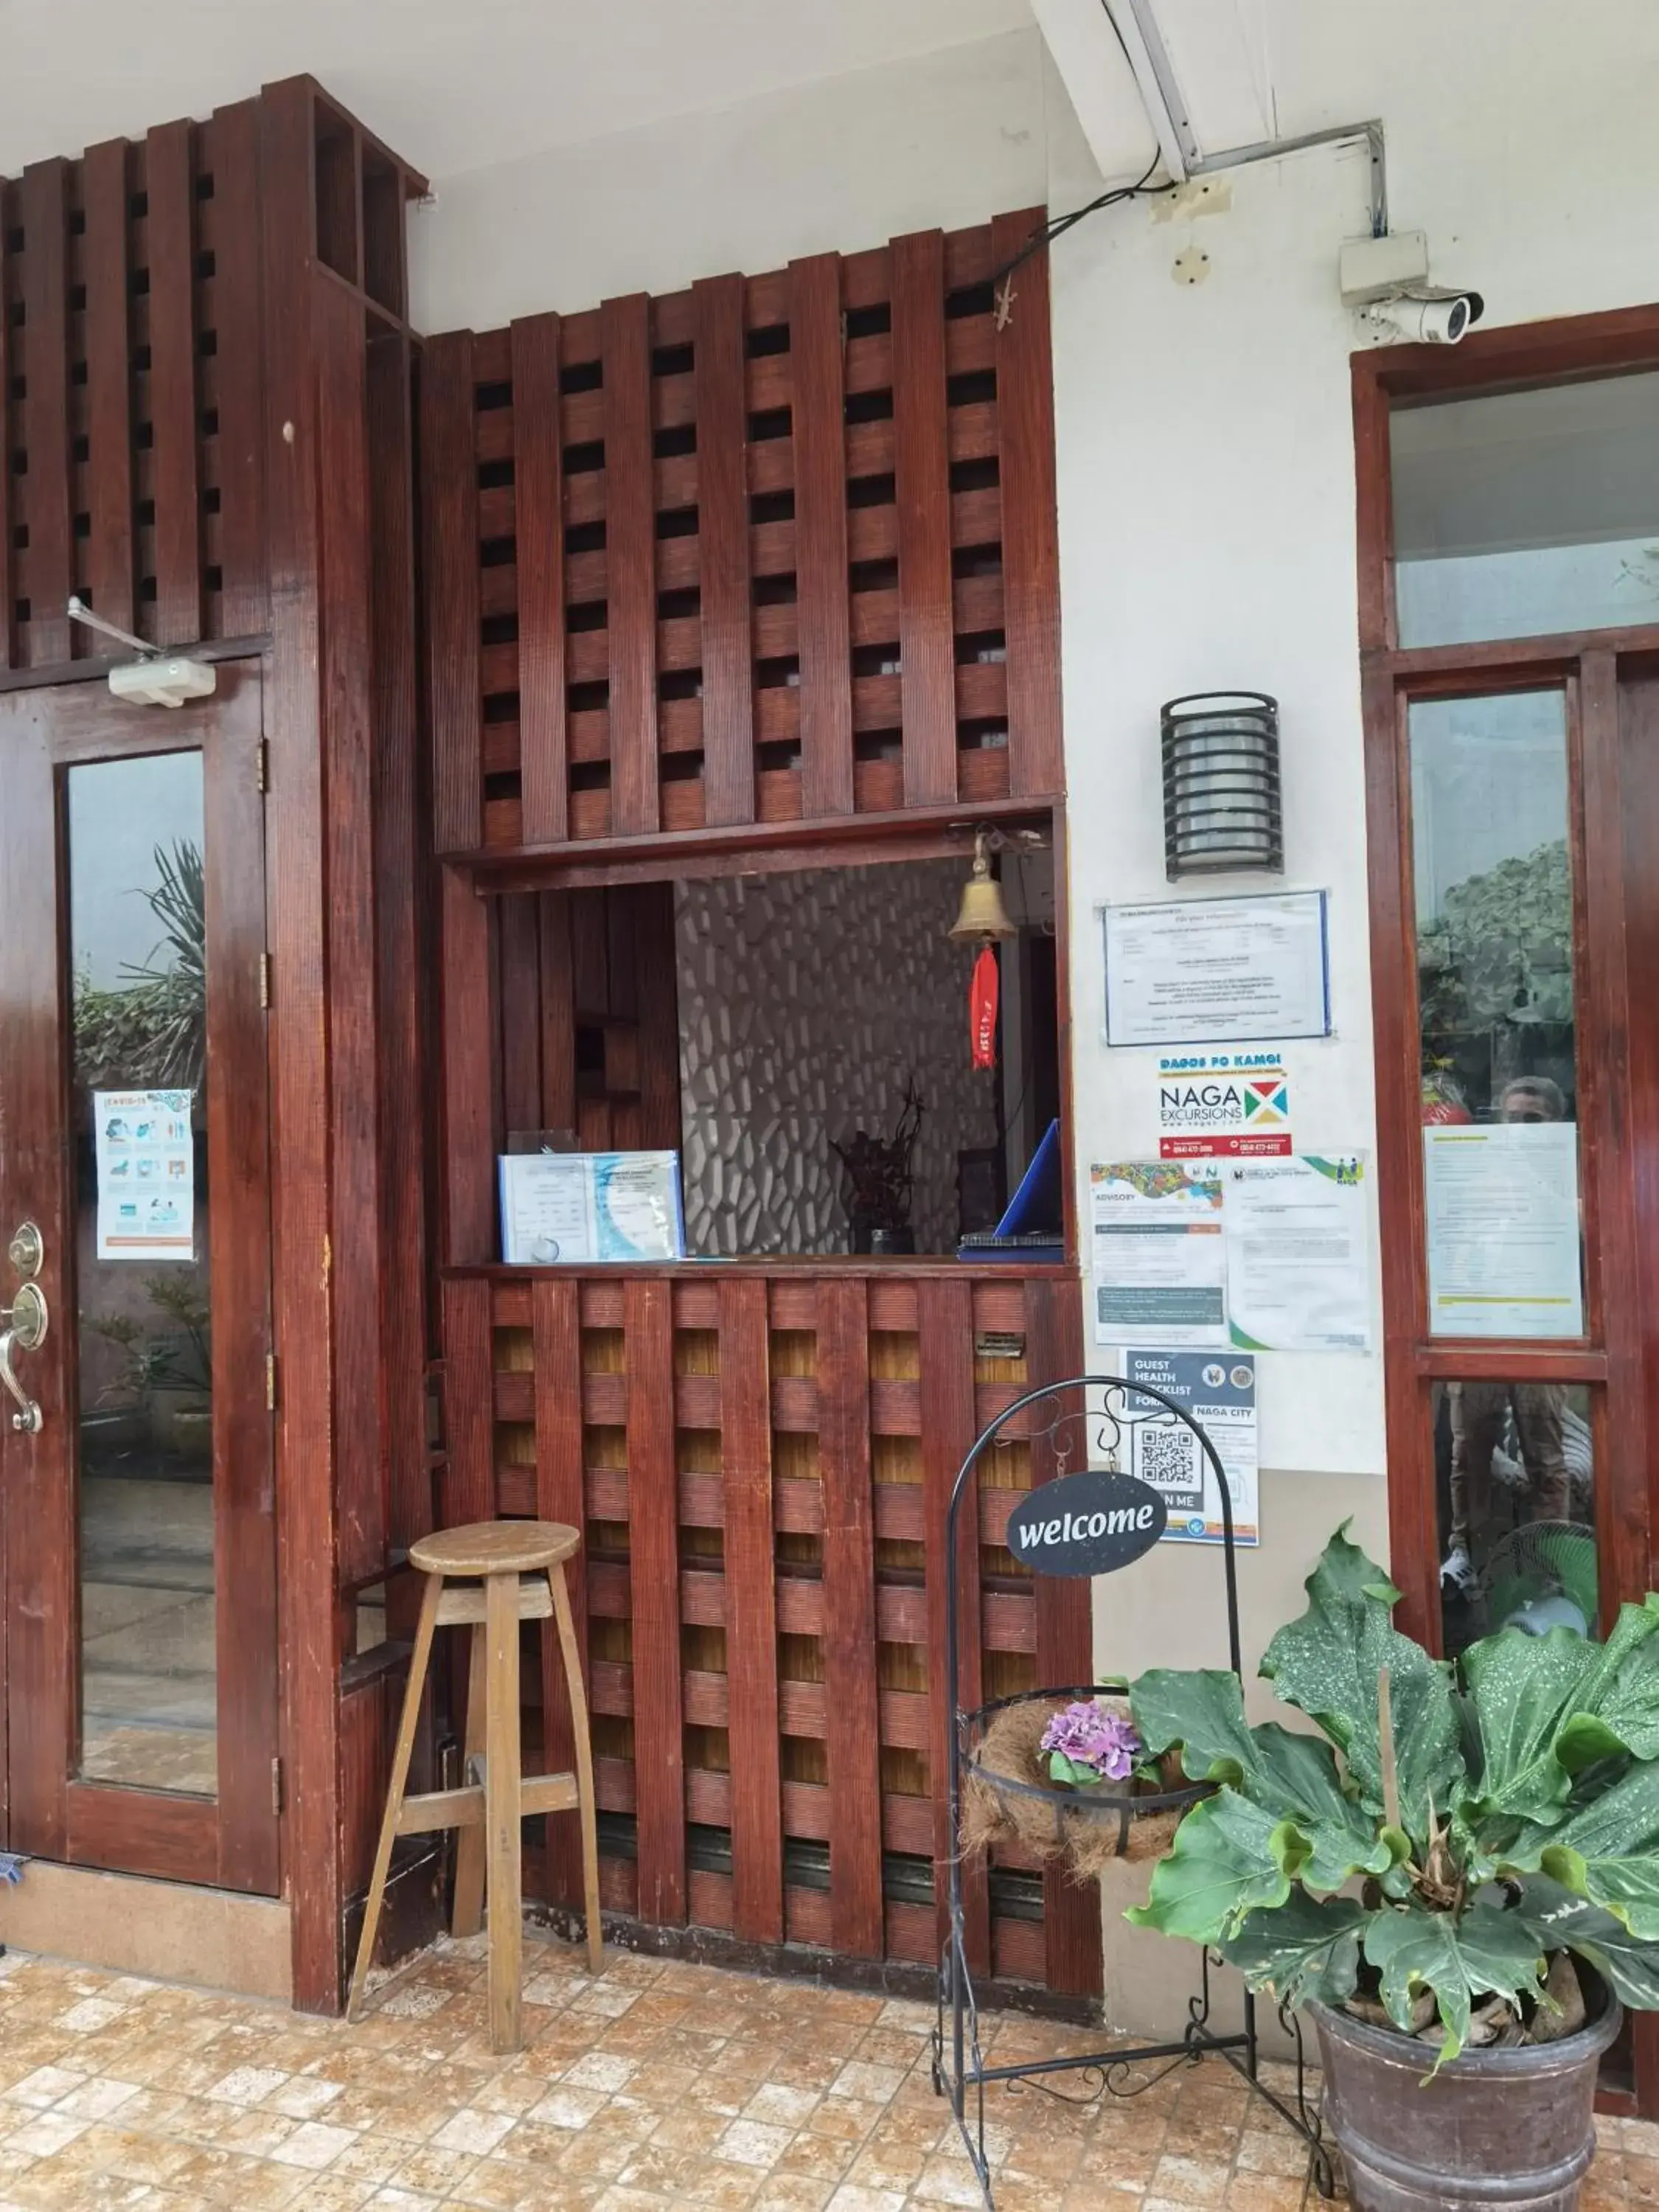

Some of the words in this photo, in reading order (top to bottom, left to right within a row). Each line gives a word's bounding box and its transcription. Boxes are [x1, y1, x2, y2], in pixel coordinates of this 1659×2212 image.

[1161, 1085, 1242, 1107] NAGA
[1161, 1107, 1242, 1121] EXCURSIONS
[1095, 1193, 1135, 1201] ADVISORY
[1135, 1360, 1170, 1370] GUEST
[1135, 1372, 1177, 1382] HEALTH
[1197, 1407, 1228, 1416] NAGA
[1230, 1409, 1252, 1417] CITY
[1177, 1495, 1194, 1506] ME
[1019, 1504, 1154, 1549] welcome
